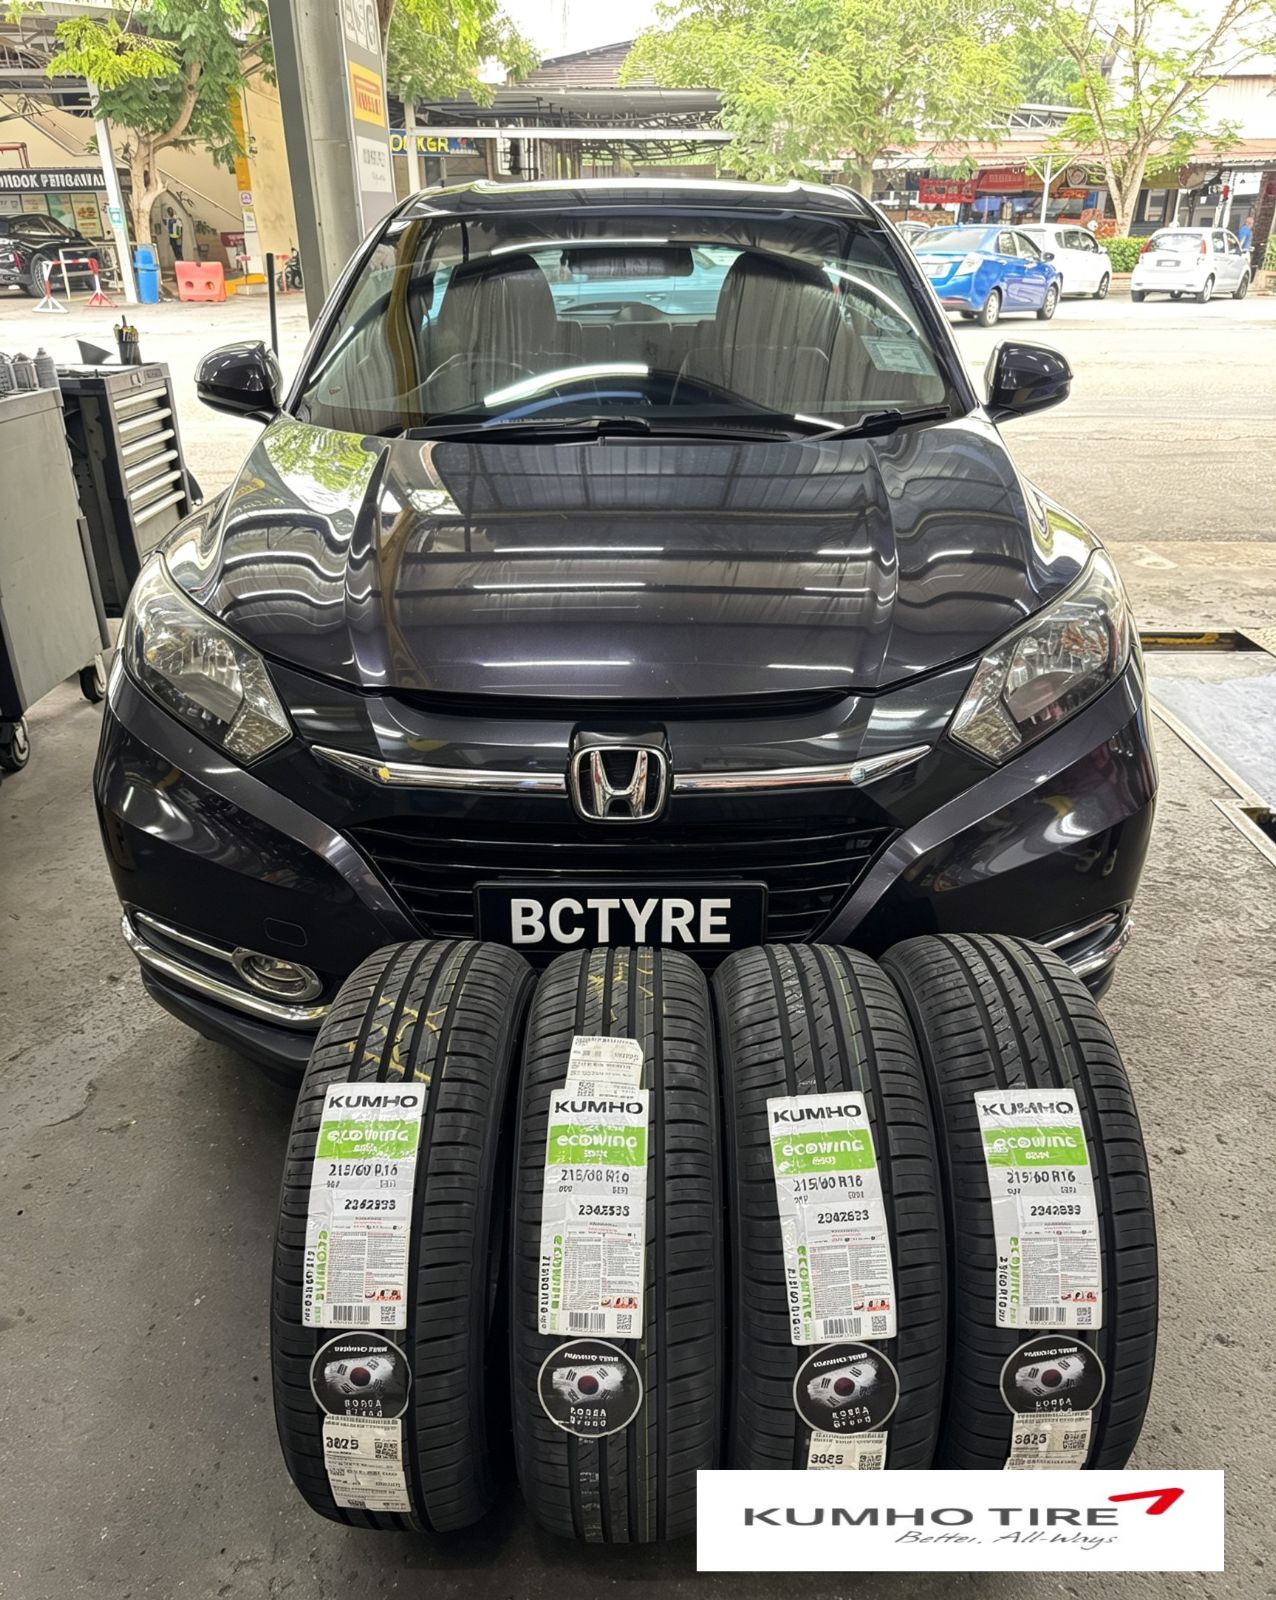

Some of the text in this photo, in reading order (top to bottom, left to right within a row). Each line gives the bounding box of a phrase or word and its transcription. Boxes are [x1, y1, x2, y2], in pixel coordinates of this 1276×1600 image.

[510, 898, 731, 944] BCTYRE
[328, 1095, 418, 1108] KUMHO
[554, 1100, 643, 1114] KUMHO
[982, 1101, 1074, 1116] KUMHO
[773, 1104, 862, 1123] KUMHO
